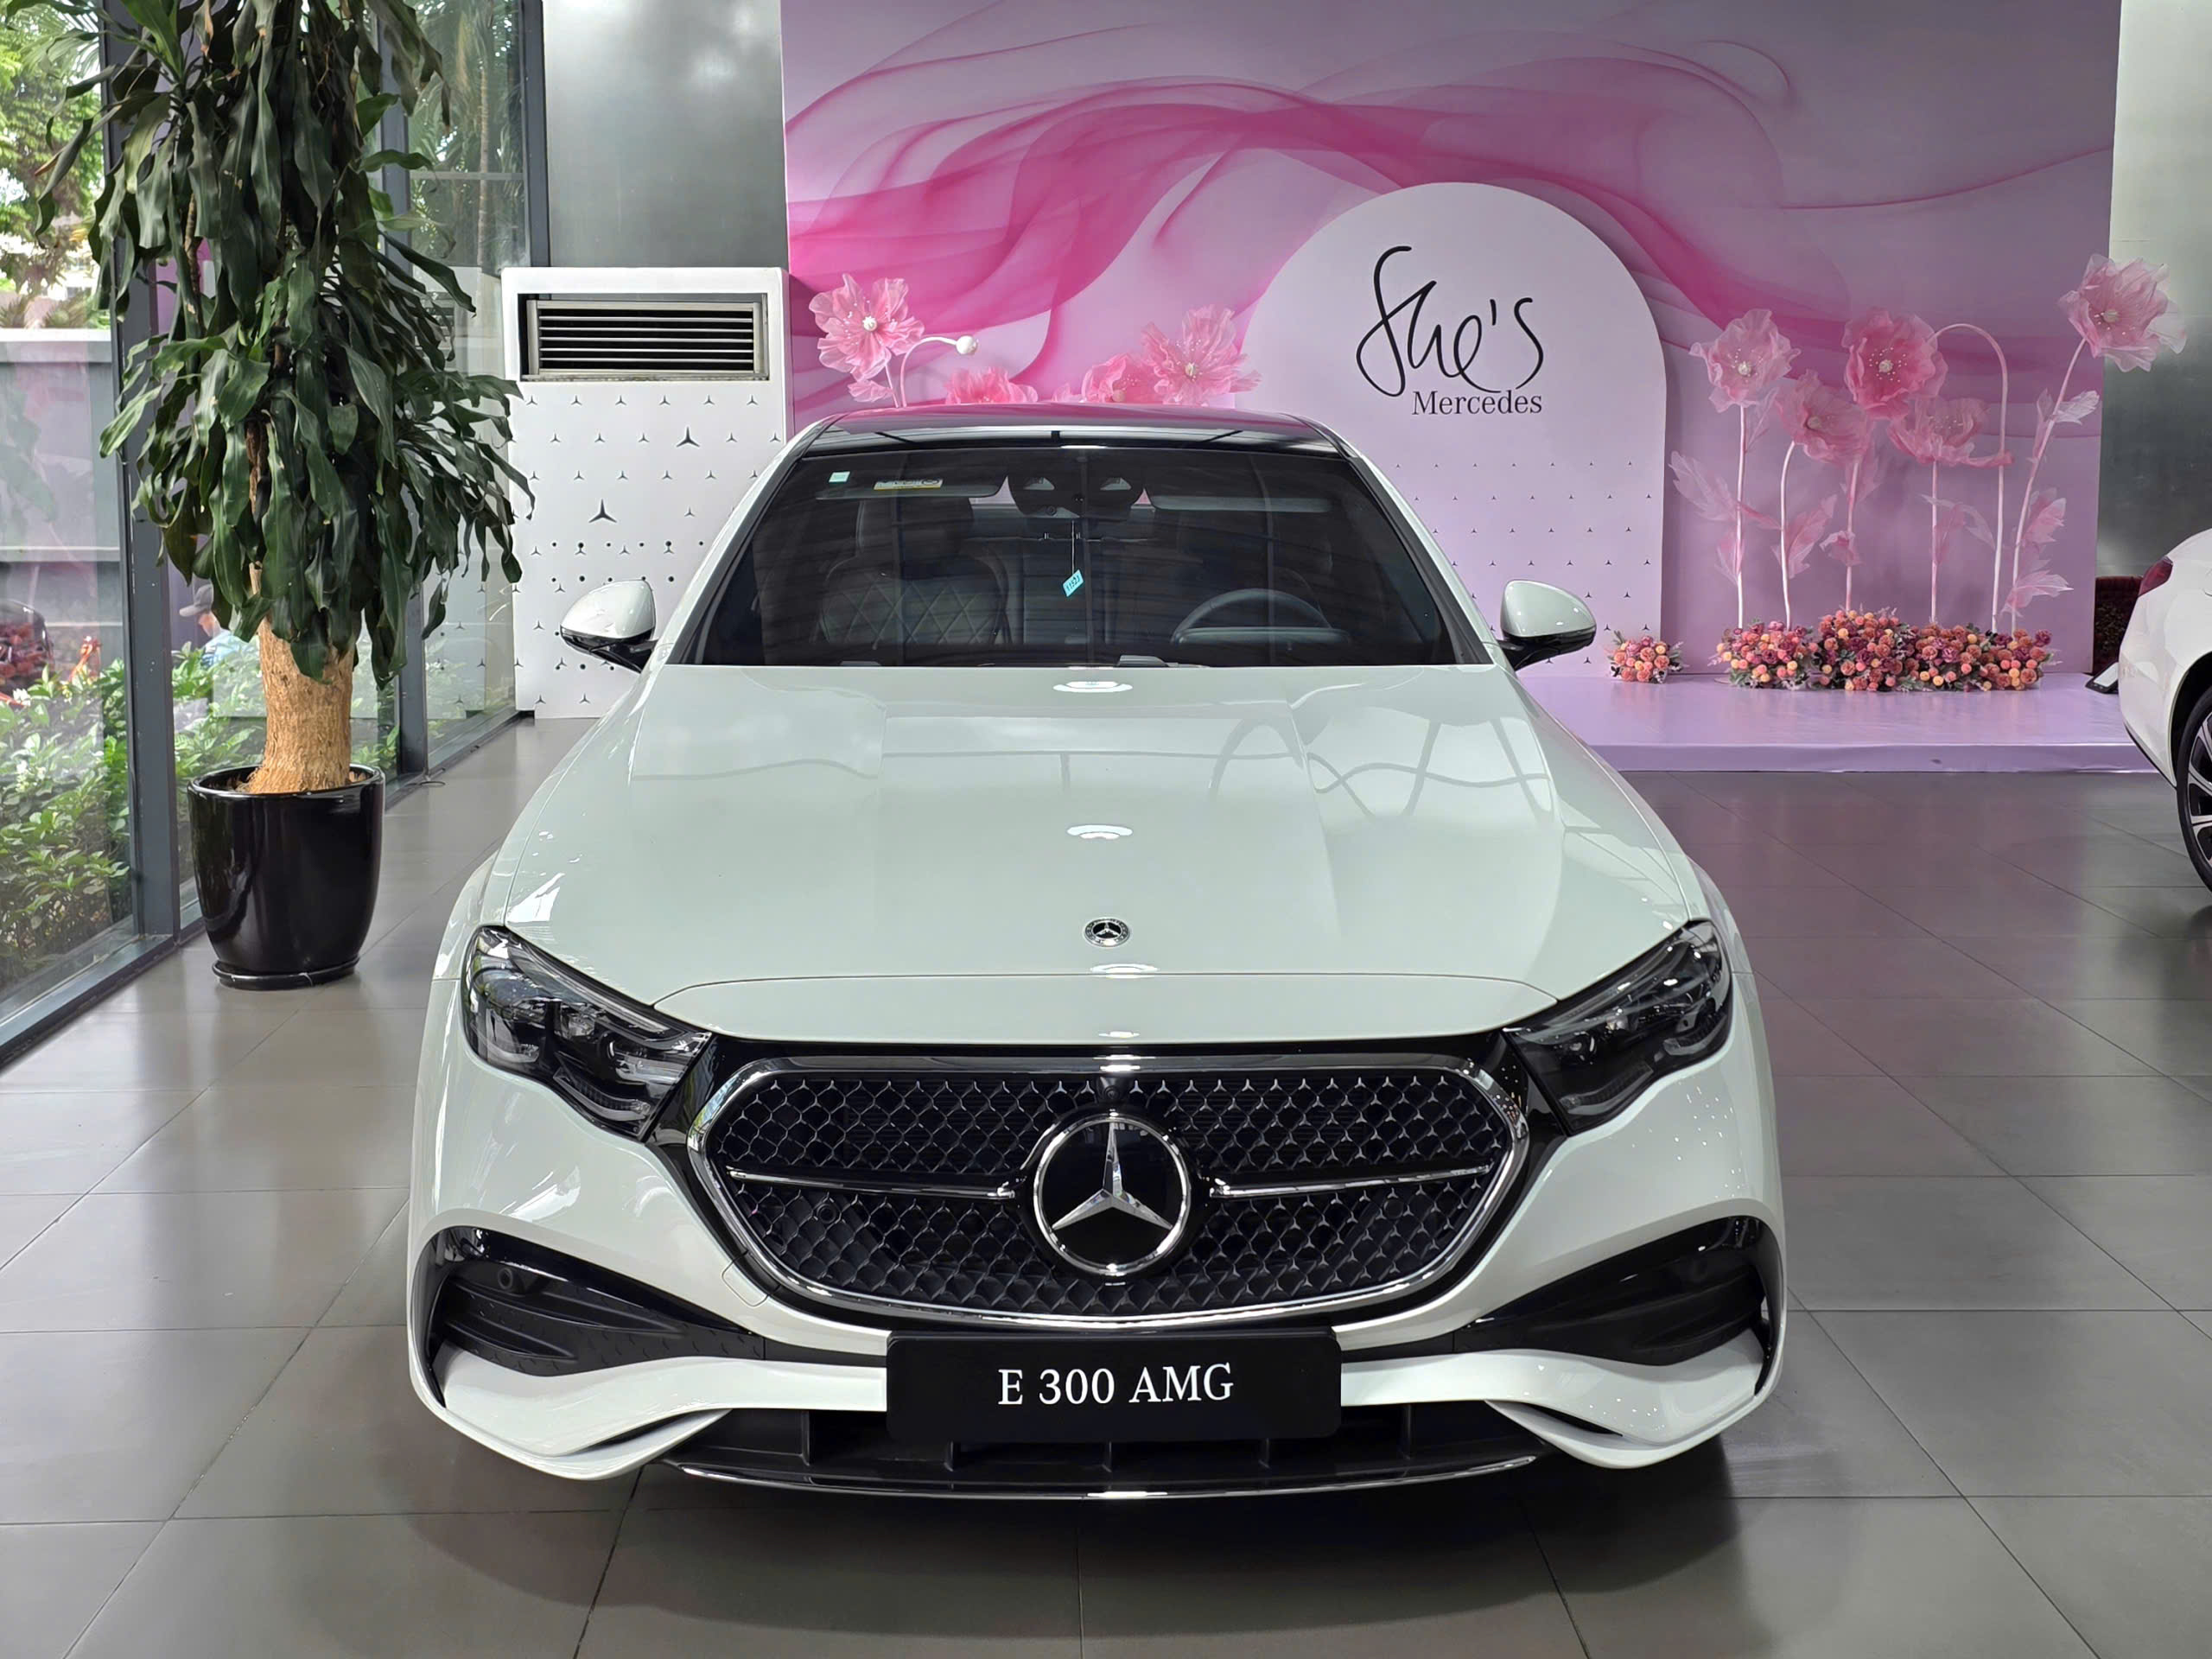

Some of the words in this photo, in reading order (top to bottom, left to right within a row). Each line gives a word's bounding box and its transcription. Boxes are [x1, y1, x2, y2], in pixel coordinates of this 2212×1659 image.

[1356, 245, 1544, 397] She's
[1412, 390, 1542, 415] Mercedes
[998, 1369, 1023, 1405] E
[1039, 1368, 1115, 1405] 300
[1128, 1362, 1234, 1403] AMG
